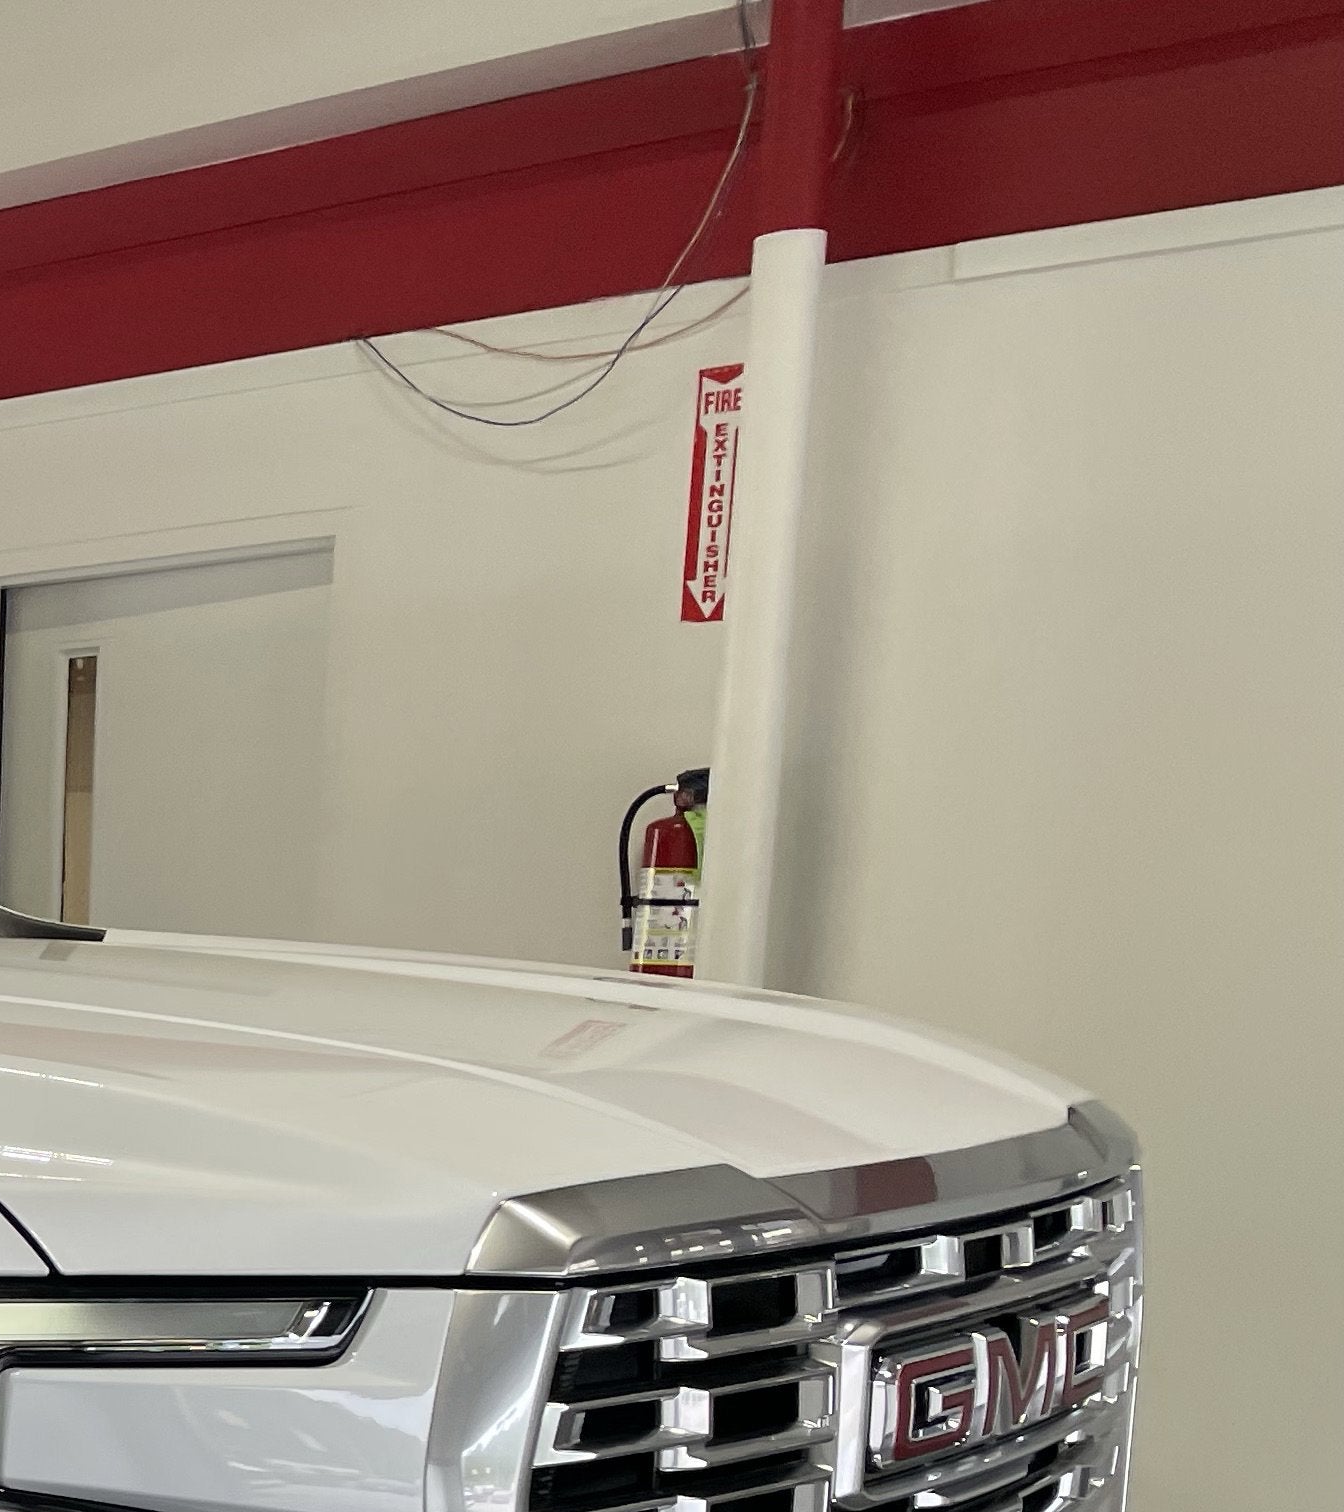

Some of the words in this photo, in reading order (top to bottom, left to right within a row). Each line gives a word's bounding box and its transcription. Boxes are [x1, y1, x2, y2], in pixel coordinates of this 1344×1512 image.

[703, 387, 742, 415] FIRE
[701, 422, 729, 603] EXTINGUISHER
[872, 1294, 1110, 1467] GMC
